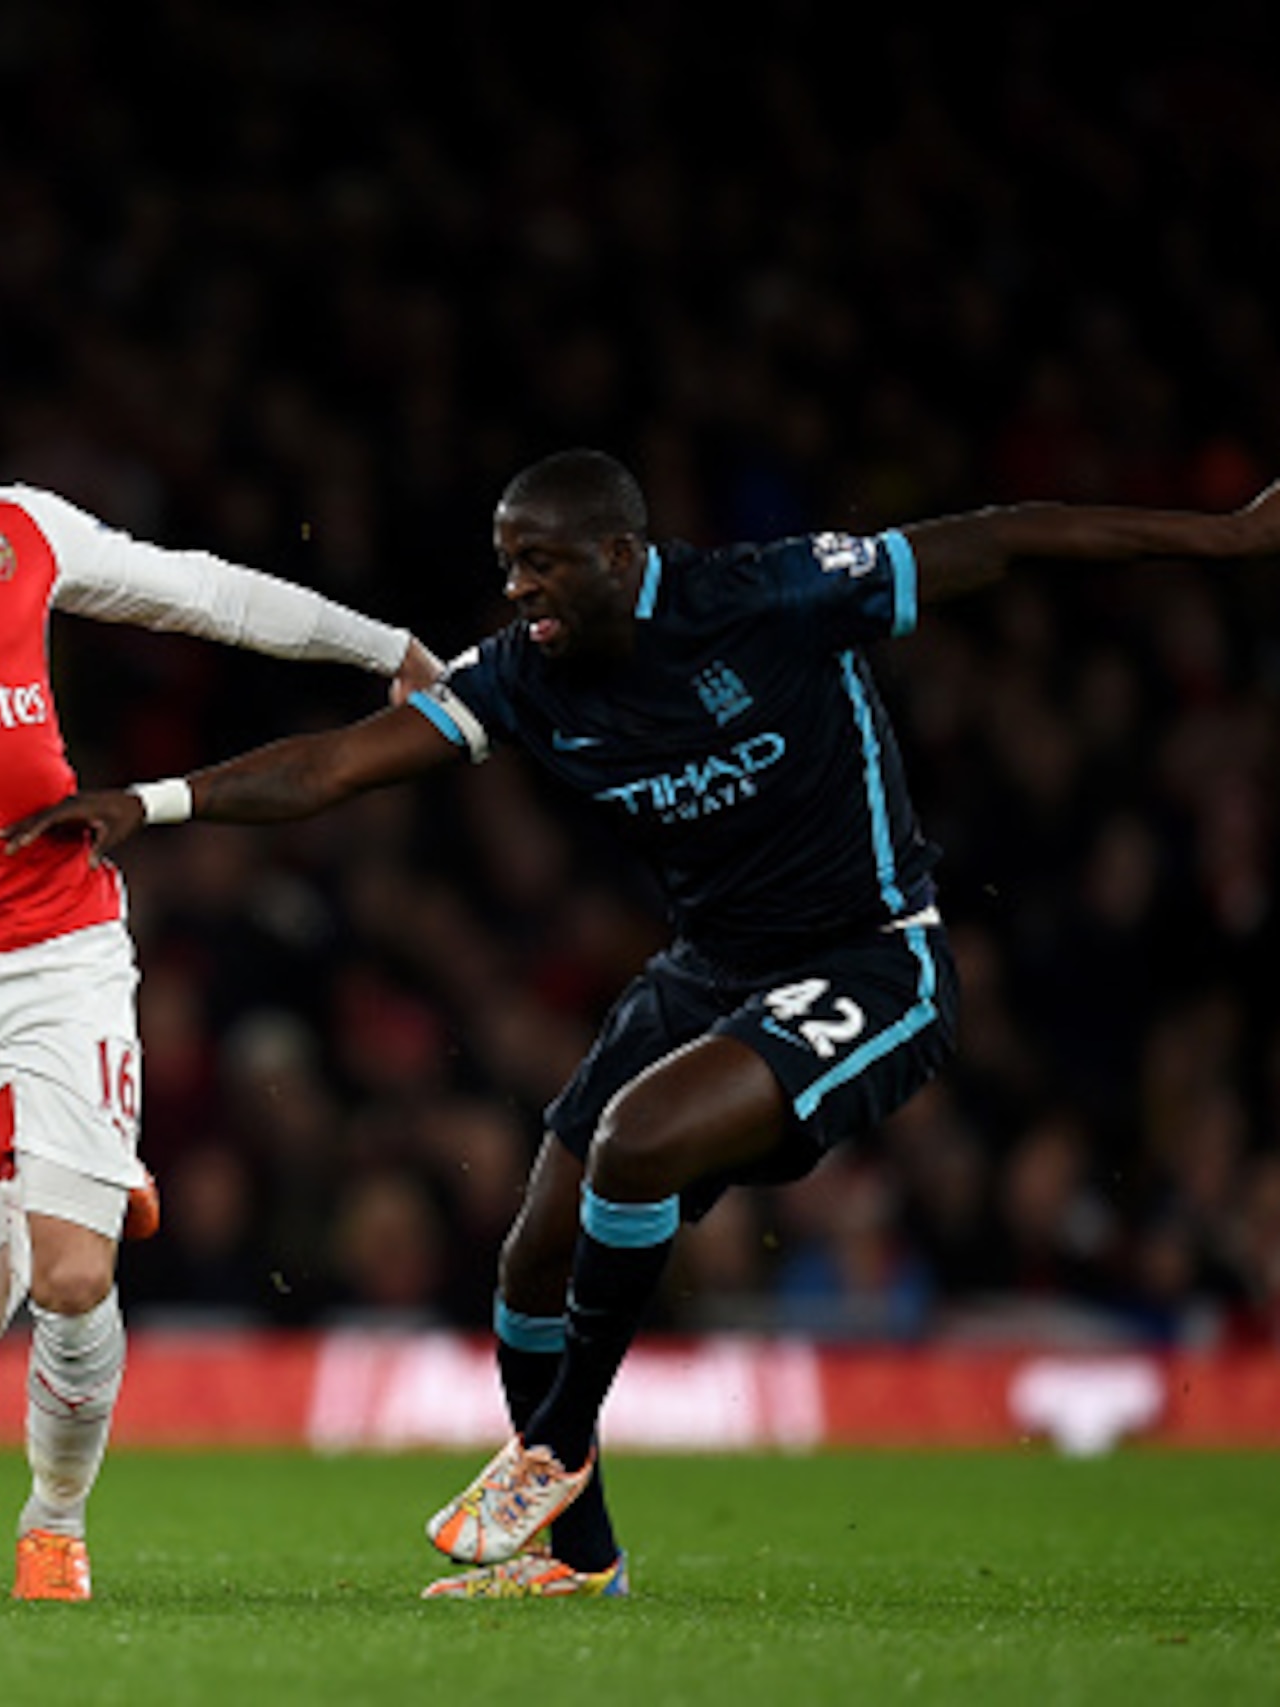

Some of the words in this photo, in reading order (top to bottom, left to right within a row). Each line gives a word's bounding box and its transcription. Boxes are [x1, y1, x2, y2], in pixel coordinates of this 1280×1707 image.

[594, 732, 786, 815] TIHAD
[763, 978, 866, 1058] 42
[96, 1037, 135, 1119] 16
